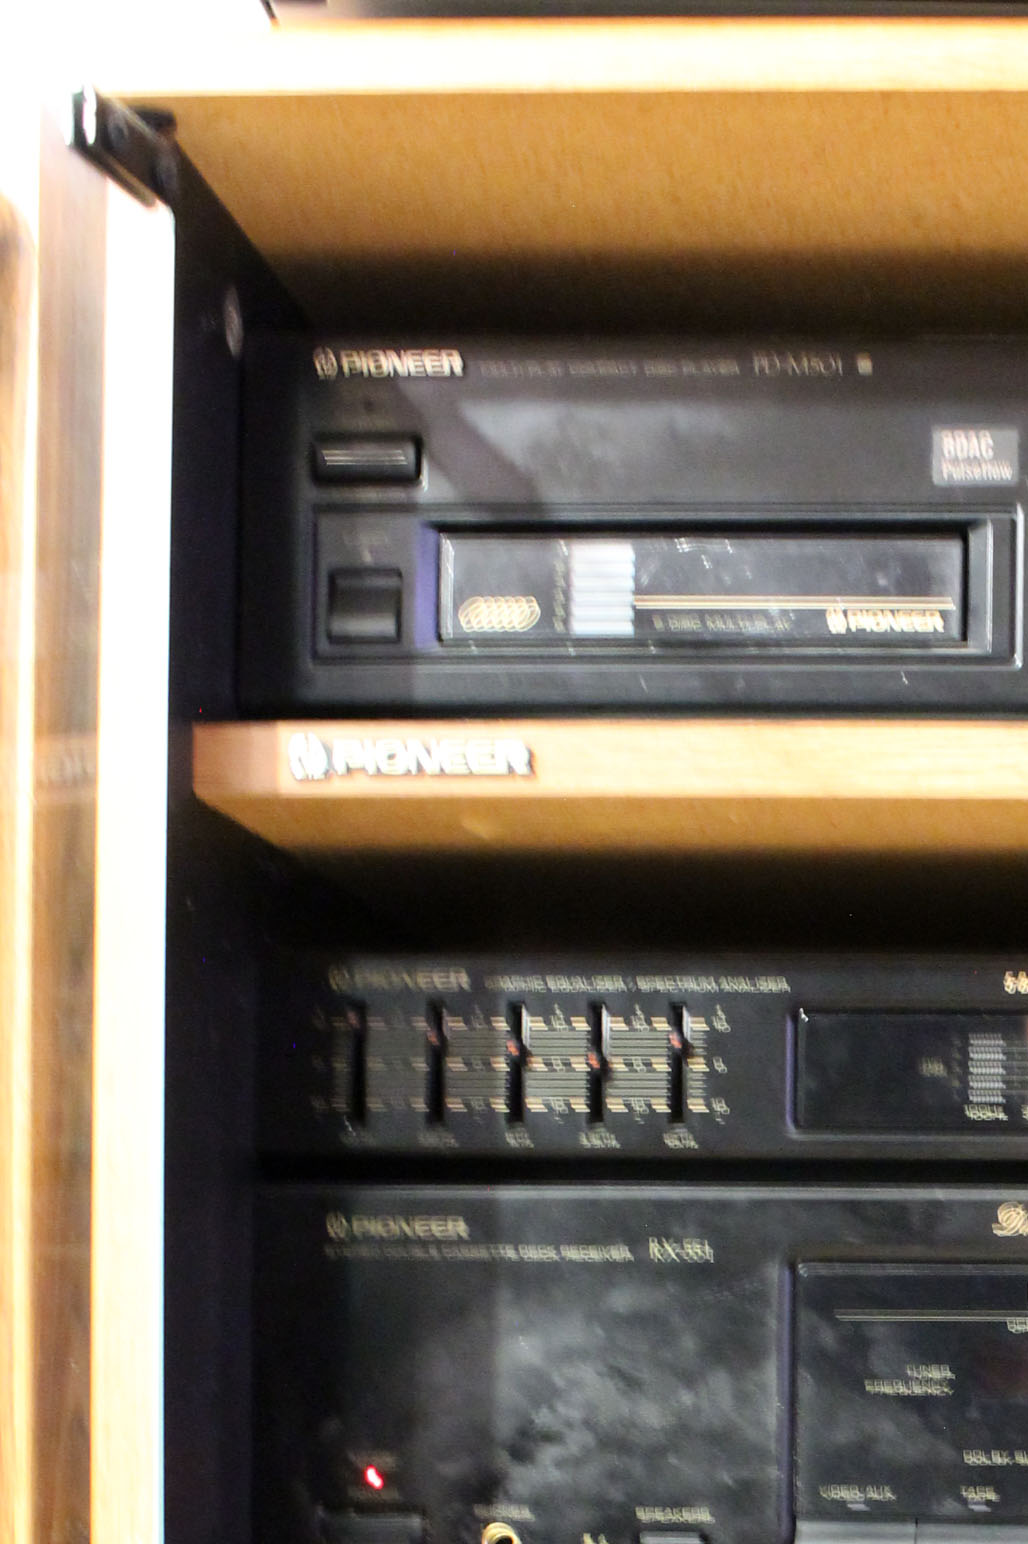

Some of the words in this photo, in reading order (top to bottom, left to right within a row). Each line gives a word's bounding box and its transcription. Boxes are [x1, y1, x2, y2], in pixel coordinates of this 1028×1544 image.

[341, 349, 463, 377] PIONEER
[848, 609, 945, 633] PIONEER
[333, 738, 536, 777] PIONEER
[353, 967, 471, 992] PIONEER
[351, 1216, 470, 1241] PIONEER
[560, 1244, 635, 1263] RECEIVER
[864, 1379, 954, 1396] FREQUENCY
[962, 1450, 1013, 1467] DOLBY
[635, 1506, 715, 1524] SPEAKERS
